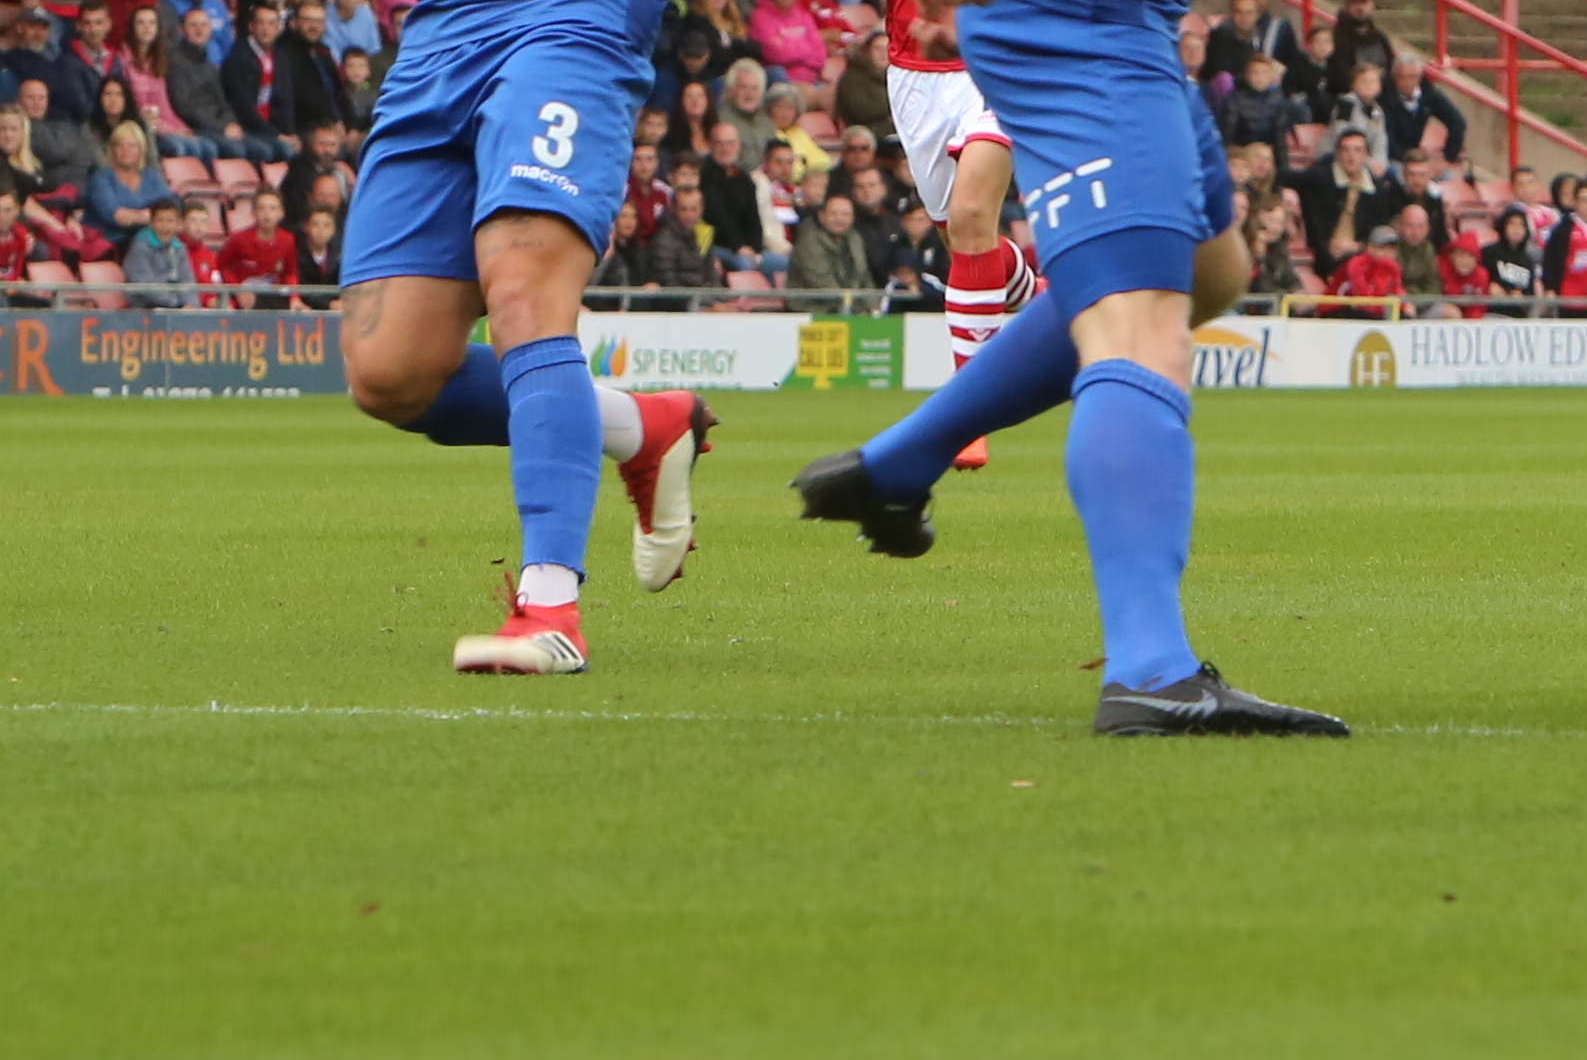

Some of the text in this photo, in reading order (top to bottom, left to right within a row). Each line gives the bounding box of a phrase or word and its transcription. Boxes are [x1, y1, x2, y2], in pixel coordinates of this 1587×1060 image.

[532, 101, 578, 169] 3
[510, 164, 579, 196] macron
[80, 316, 268, 380] Engineering
[276, 316, 325, 365] Ltd
[632, 348, 737, 374] SP ENERGY
[1410, 325, 1540, 366] HADLOW
